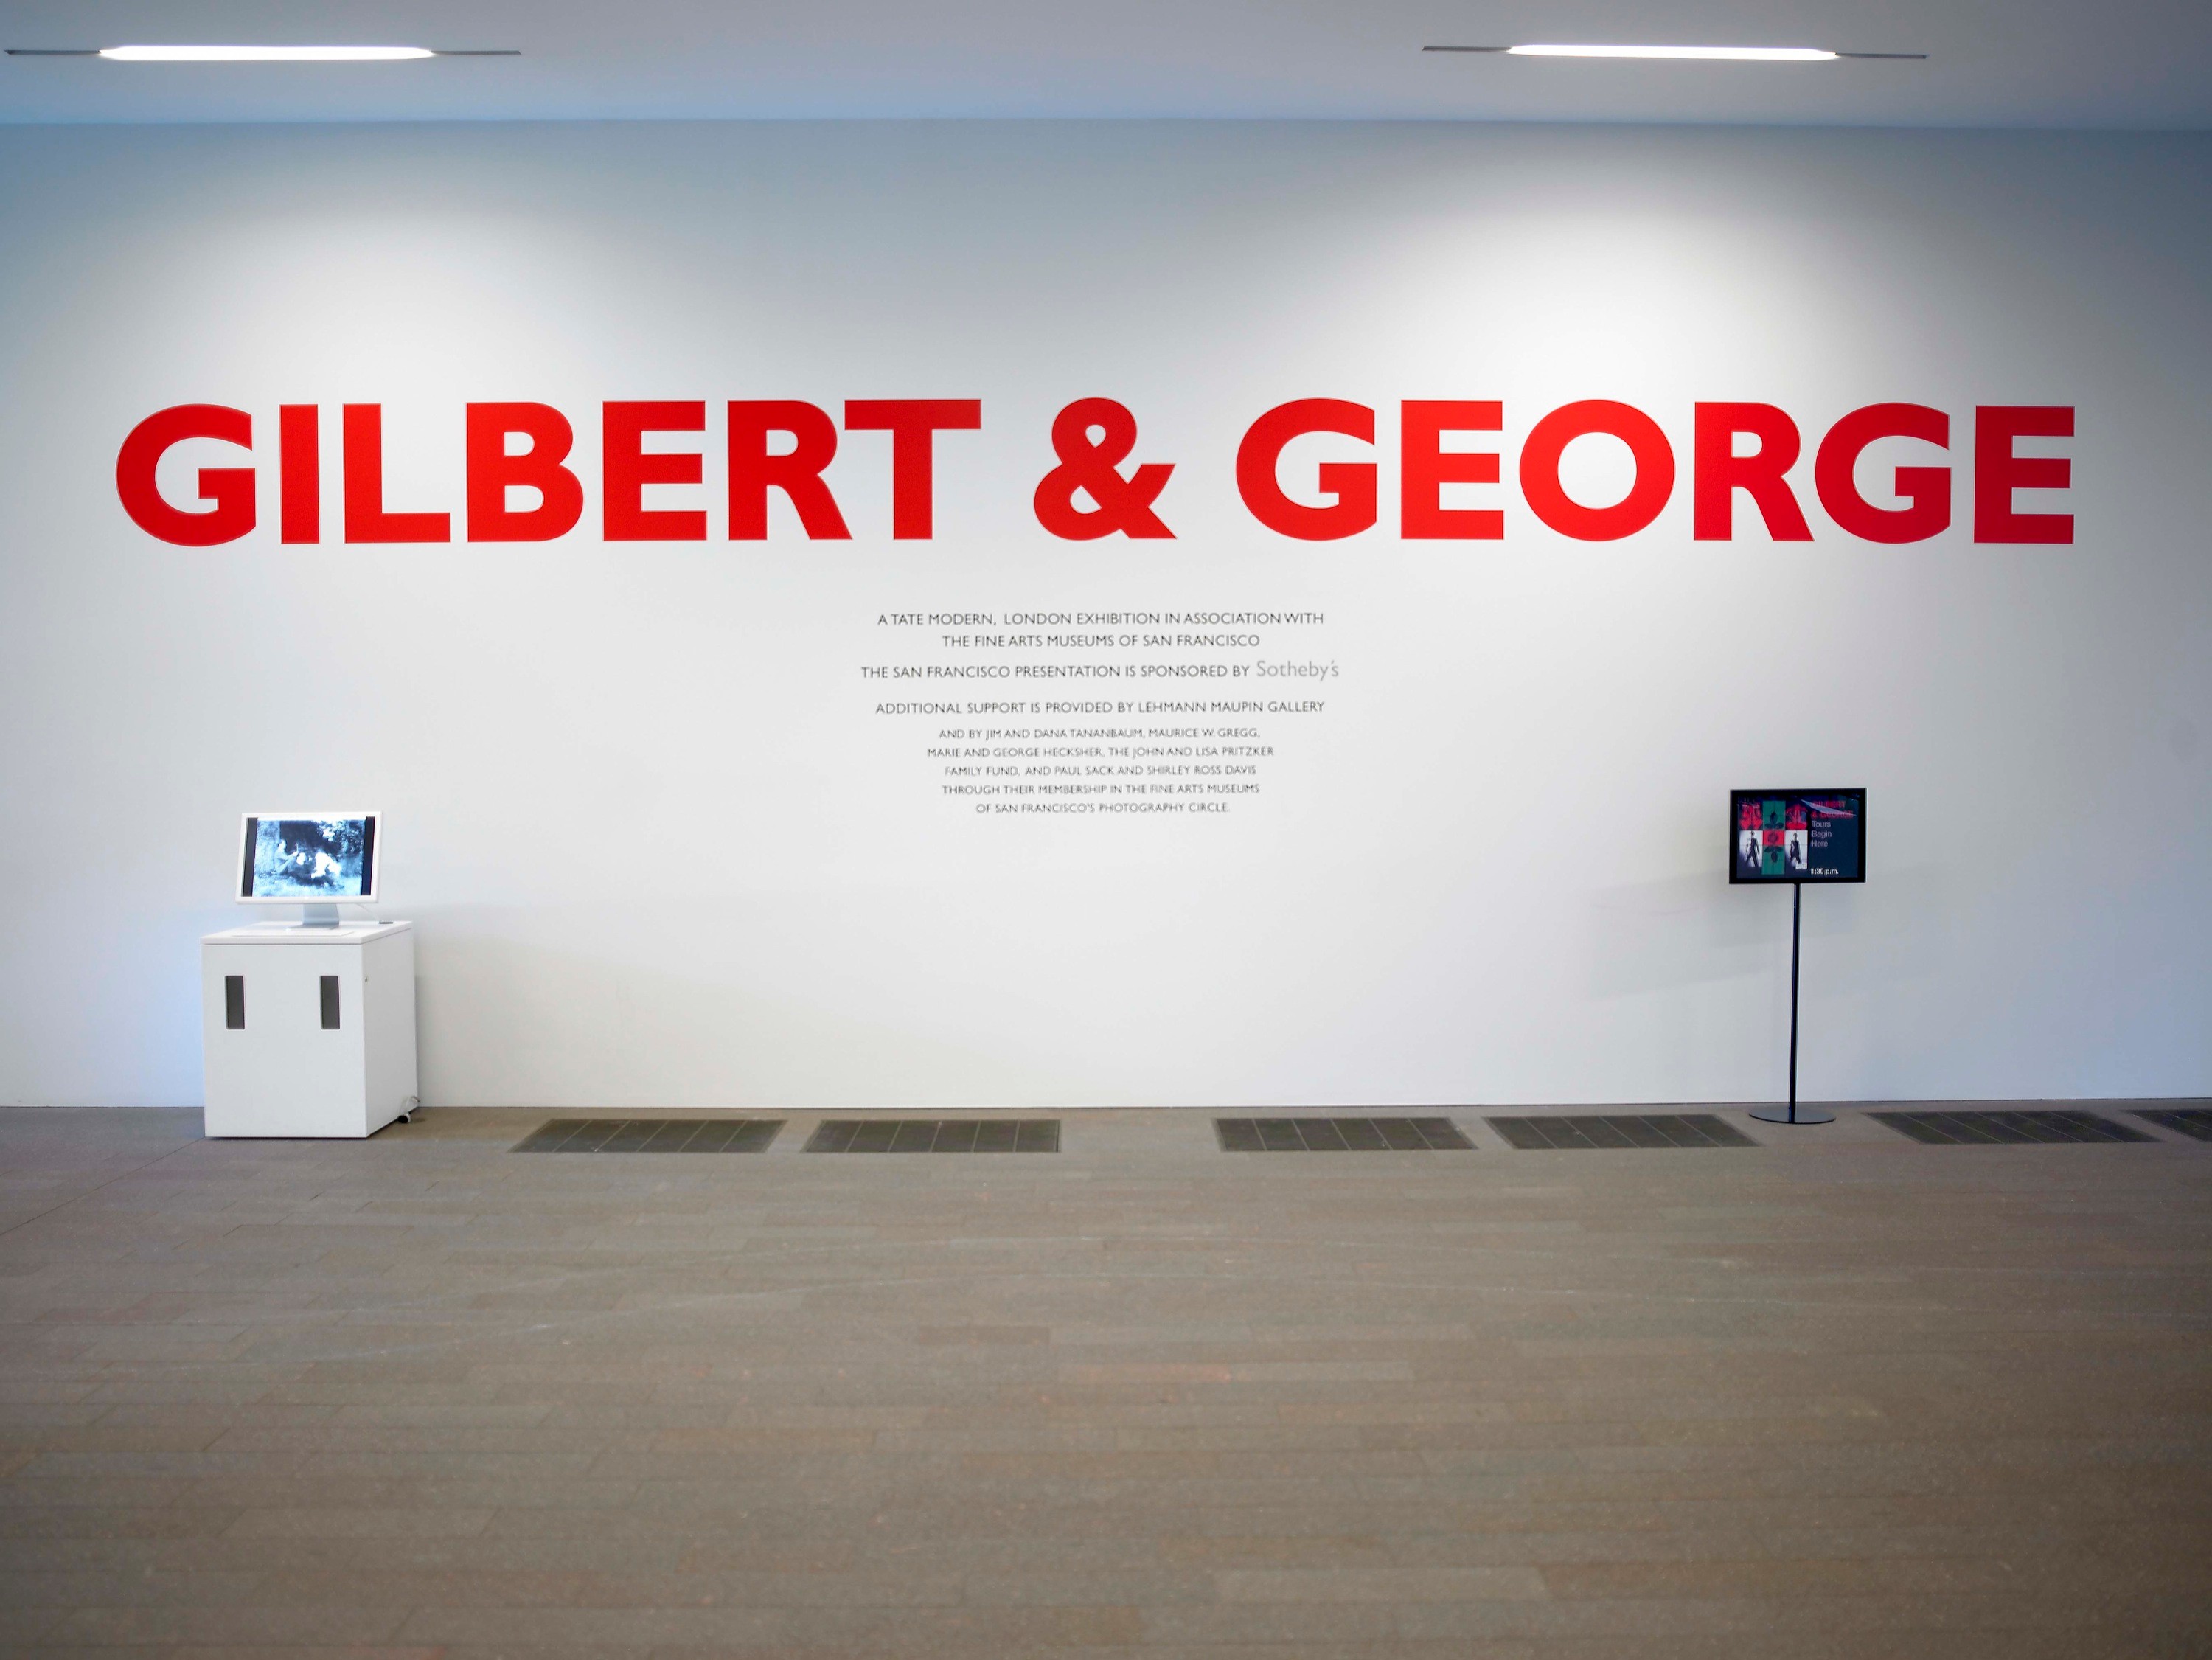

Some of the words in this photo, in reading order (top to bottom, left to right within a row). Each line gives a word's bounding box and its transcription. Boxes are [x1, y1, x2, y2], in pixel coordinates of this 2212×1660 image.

[116, 399, 981, 547] GILBERT
[1033, 397, 1176, 541] &
[1235, 397, 2074, 544] GEORGE
[877, 614, 888, 626] A
[890, 613, 924, 626] TATE
[928, 612, 998, 627] MODERN,
[1004, 612, 1072, 626] LONDON
[1076, 612, 1161, 625] EXHIBITION
[1164, 612, 1180, 625] IN
[1183, 611, 1281, 625] ASSOCIATION
[1283, 612, 1324, 625] WITH
[942, 634, 970, 648] THE
[974, 634, 1006, 648] FINE
[1007, 634, 1043, 648] ARTS
[1046, 634, 1115, 647] MUSEUMS
[1118, 633, 1139, 647] OF
[1142, 633, 1172, 647] SAN
[1176, 633, 1261, 647] FRANCISCO
[860, 666, 889, 679] THE
[892, 665, 922, 679] SAN
[926, 665, 1011, 679] FRANCISCO
[1015, 664, 1121, 678] PRESENTATION
[1124, 664, 1137, 678] IS
[1140, 664, 1228, 678] SPONSORED
[1232, 664, 1251, 678] BY
[1256, 660, 1339, 681] Sotheby's
[874, 702, 963, 715] ADDITIONAL
[966, 701, 1027, 715] SUPPORT
[1030, 701, 1041, 715] IS
[1045, 701, 1113, 714] PROVIDED
[1117, 701, 1134, 714] BY
[1138, 701, 1206, 714] LEHMANN
[1210, 701, 1264, 713] MAUPIN
[1267, 701, 1325, 713] GALLERY
[938, 729, 966, 740] AND
[968, 729, 983, 740] BY
[985, 729, 1002, 741] JIM
[1003, 728, 1031, 739] AND
[1033, 728, 1068, 739] DANA
[1069, 728, 1146, 739] TANANBAUM,
[1148, 727, 1199, 738] MAURICE
[1217, 727, 1261, 738] GREGG,
[927, 747, 961, 758] MARIE
[963, 747, 990, 758] AND
[992, 746, 1040, 758] GEORGE
[1043, 746, 1105, 758] HECKSHER,
[1107, 746, 1130, 757] THE
[1132, 746, 1164, 760] JOHN
[1165, 746, 1194, 757] AND
[1195, 746, 1220, 757] LISA
[1221, 746, 1275, 757] PRITZKER
[945, 765, 983, 777] FAMILY
[985, 765, 1021, 777] FUND,
[1024, 765, 1051, 777] AND
[1054, 765, 1082, 777] PAUL
[1085, 765, 1115, 777] SACK
[1116, 765, 1144, 777] AND
[1146, 765, 1191, 776] SHIRLEY
[1193, 765, 1222, 776] ROSS
[1225, 764, 1257, 776] DAVIS
[942, 784, 1001, 796] THROUGH
[1003, 784, 1036, 796] THEIR
[1037, 784, 1107, 795] MEMBERSHIP
[1109, 784, 1123, 794] IN
[1124, 783, 1147, 795] THE
[1150, 783, 1175, 795] FINE
[1176, 783, 1205, 794] ARTS
[1206, 783, 1260, 794] MUSEUMS
[975, 803, 992, 814] OF
[994, 803, 1018, 814] SAN
[1020, 802, 1096, 814] FRANCISCO'S
[1098, 802, 1185, 813] PHOTOGRAPHY
[1187, 802, 1231, 813] CIRCLE.
[1812, 830, 1832, 838] Begin
